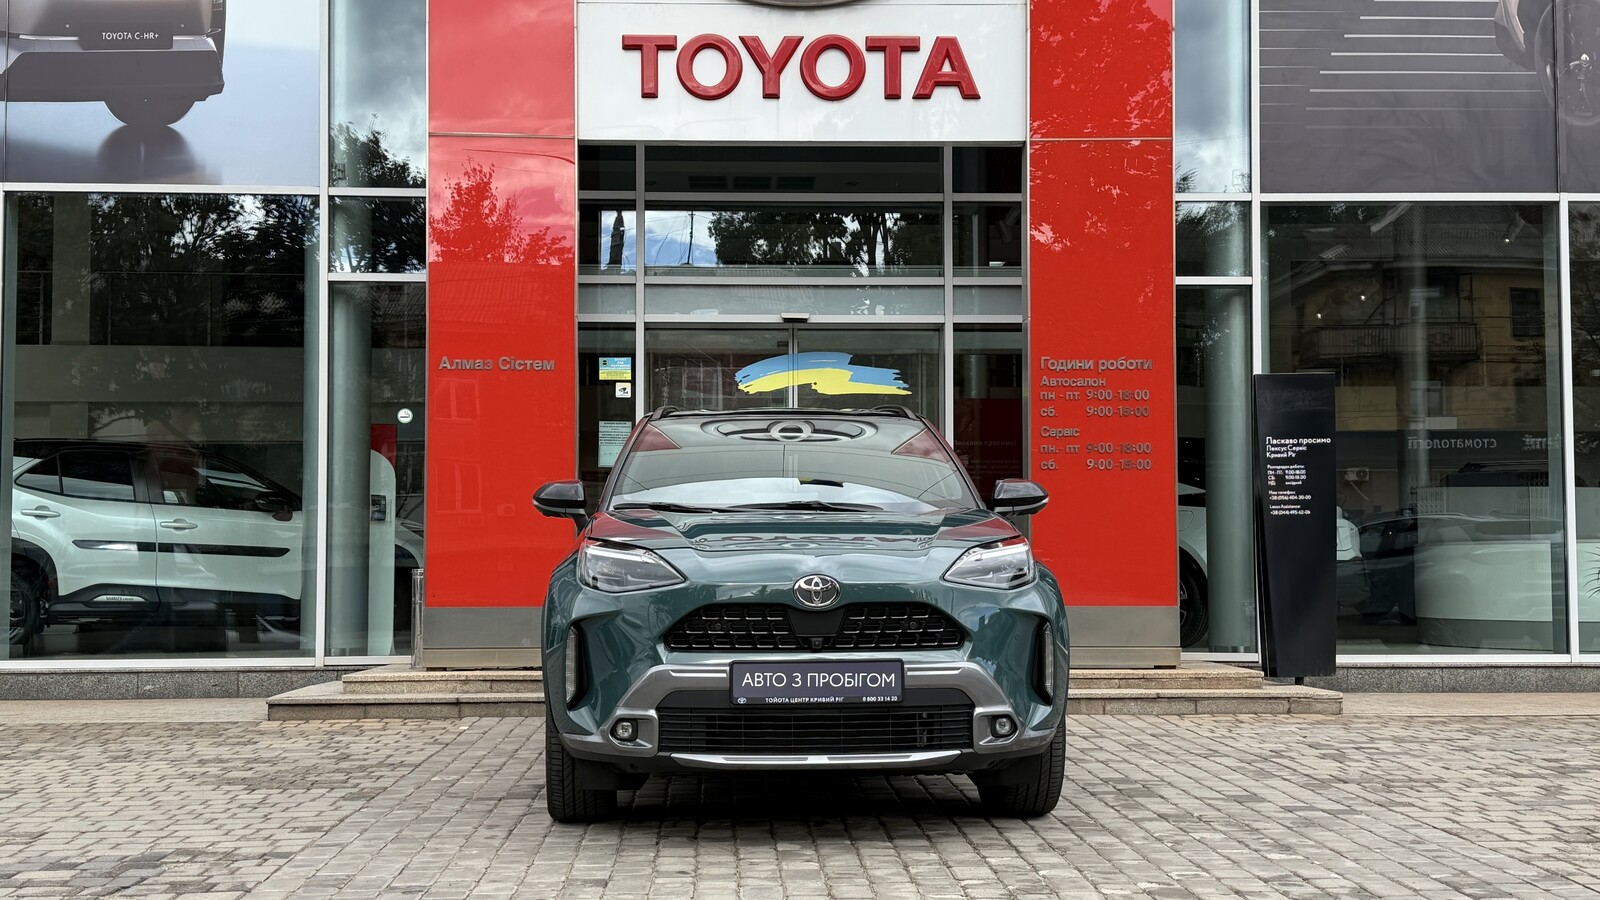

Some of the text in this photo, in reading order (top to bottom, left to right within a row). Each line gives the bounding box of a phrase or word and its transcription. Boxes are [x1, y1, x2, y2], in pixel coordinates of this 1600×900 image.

[101, 32, 159, 40] TOYOTA C-HR+
[622, 34, 981, 100] TOYOTA
[438, 355, 555, 371] Алмаз Сістем
[1040, 356, 1153, 373] Години роботи
[1040, 376, 1106, 387] Автосалон
[1040, 406, 1058, 417] сб.
[1040, 425, 1080, 439] Сервіс
[1266, 436, 1331, 445] Ласкаво просимо
[1040, 459, 1058, 470] сб.
[742, 672, 787, 688] АВТО
[807, 672, 895, 688] ПРОБІГОМ
